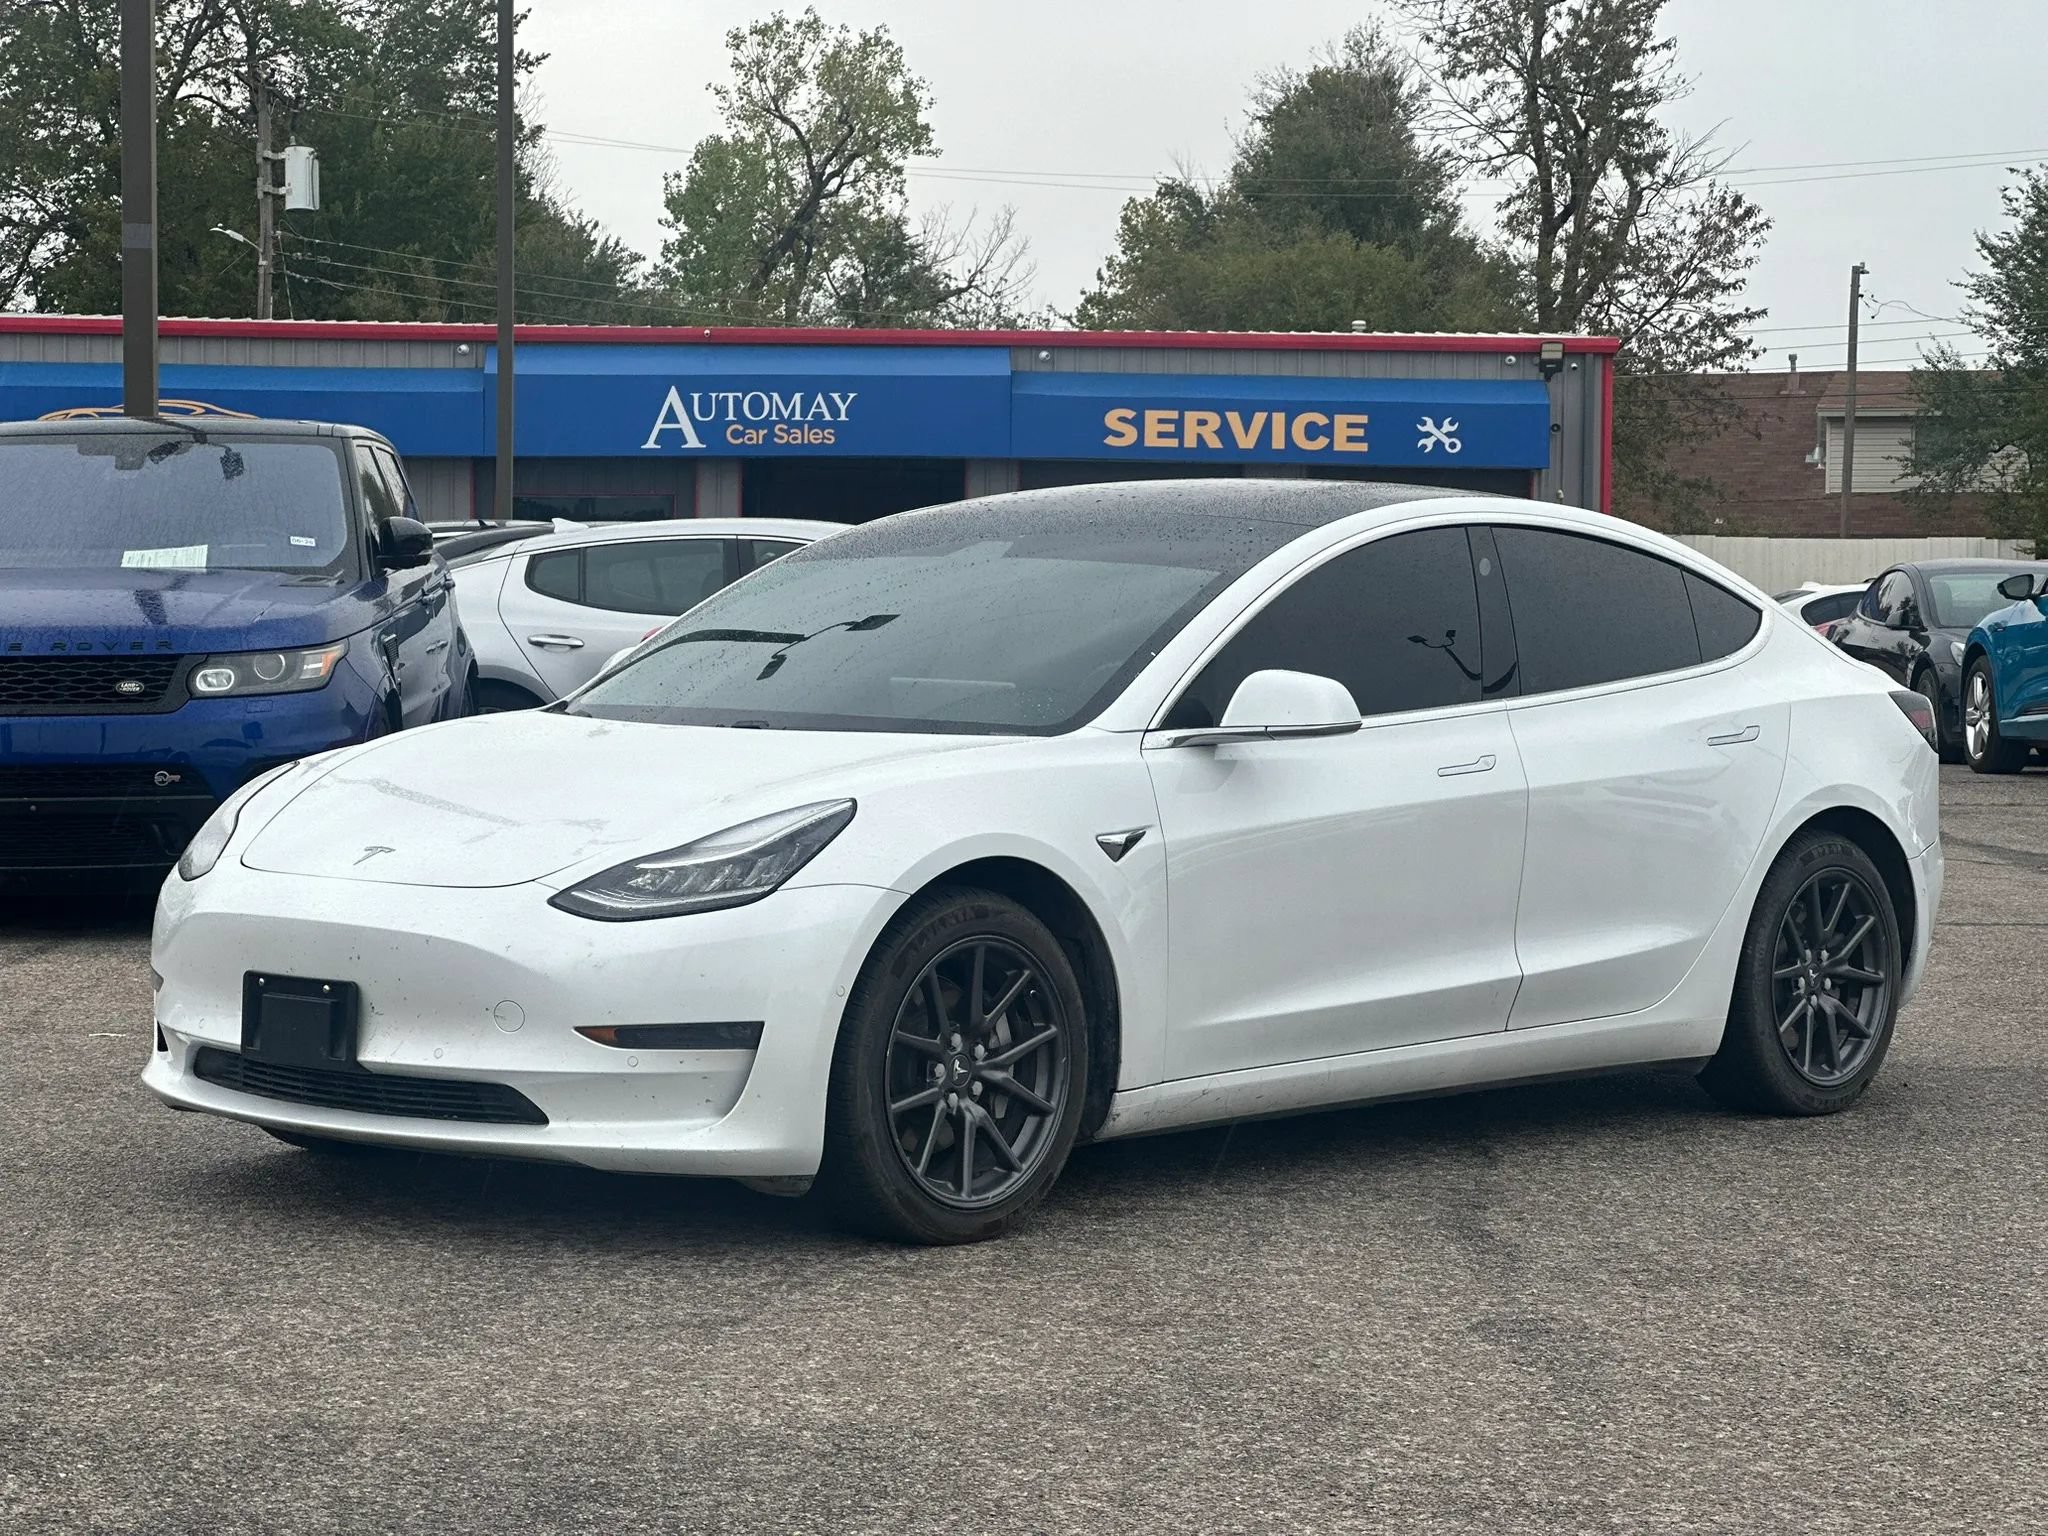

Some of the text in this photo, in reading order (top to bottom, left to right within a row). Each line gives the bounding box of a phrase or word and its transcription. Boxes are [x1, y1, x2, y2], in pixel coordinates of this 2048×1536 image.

[641, 385, 858, 449] AUTOMAY
[1103, 407, 1369, 452] SERVICE
[726, 423, 836, 445] Car Sales
[51, 640, 173, 651] ROVER
